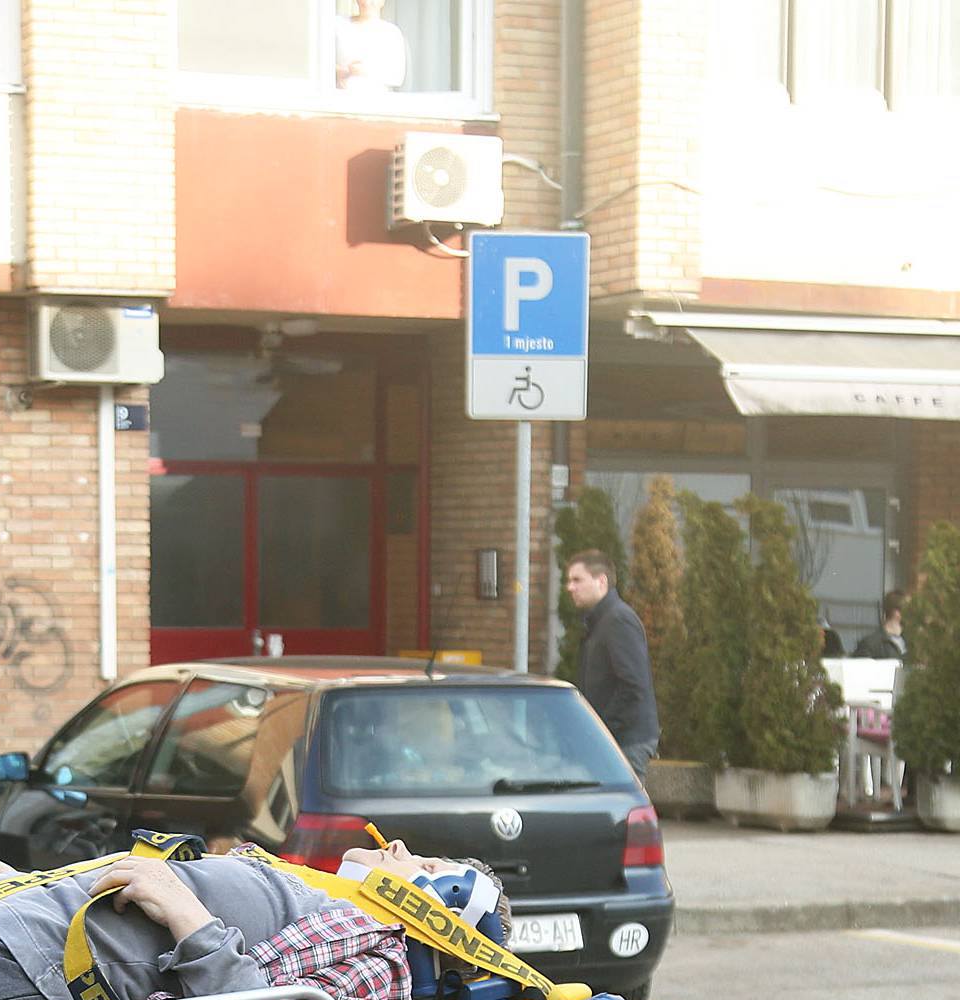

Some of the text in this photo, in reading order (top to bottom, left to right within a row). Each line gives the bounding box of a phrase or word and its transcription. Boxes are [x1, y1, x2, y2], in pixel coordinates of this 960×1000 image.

[504, 257, 554, 332] P
[515, 335, 554, 352] mjesto
[853, 394, 944, 408] CAFFE
[376, 877, 552, 996] SPENCER
[619, 929, 642, 951] HR
